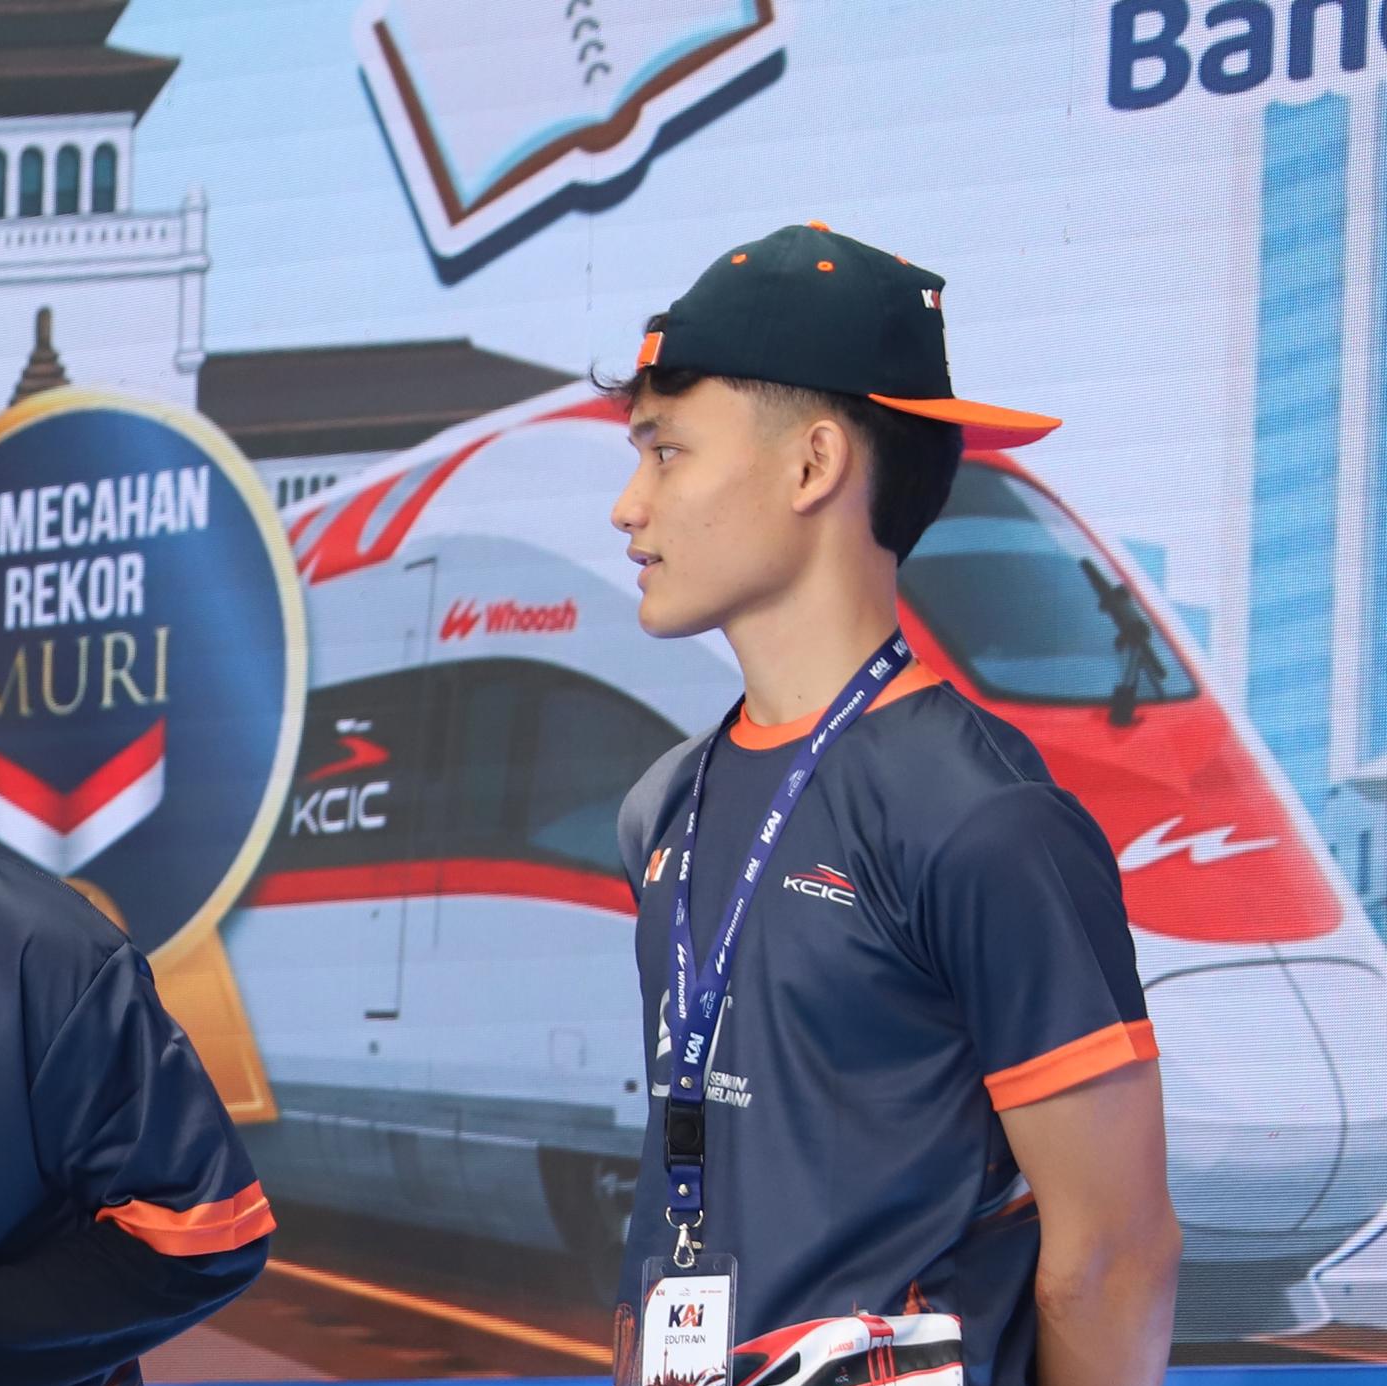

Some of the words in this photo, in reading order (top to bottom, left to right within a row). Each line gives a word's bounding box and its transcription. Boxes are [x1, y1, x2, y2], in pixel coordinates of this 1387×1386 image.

[1108, 0, 1387, 111] Ban
[3, 554, 145, 630] REKOR
[484, 597, 577, 633] Whoosh
[827, 690, 866, 731] Whoosh
[291, 781, 390, 836] KCIC
[760, 810, 783, 844] KAI
[783, 875, 856, 907] KCIC
[724, 897, 745, 947] Whoosh
[677, 971, 687, 1020] Whoosh
[683, 1032, 705, 1064] KAI
[668, 1303, 705, 1328] KAI
[664, 1334, 706, 1345] EDUTRAIN
